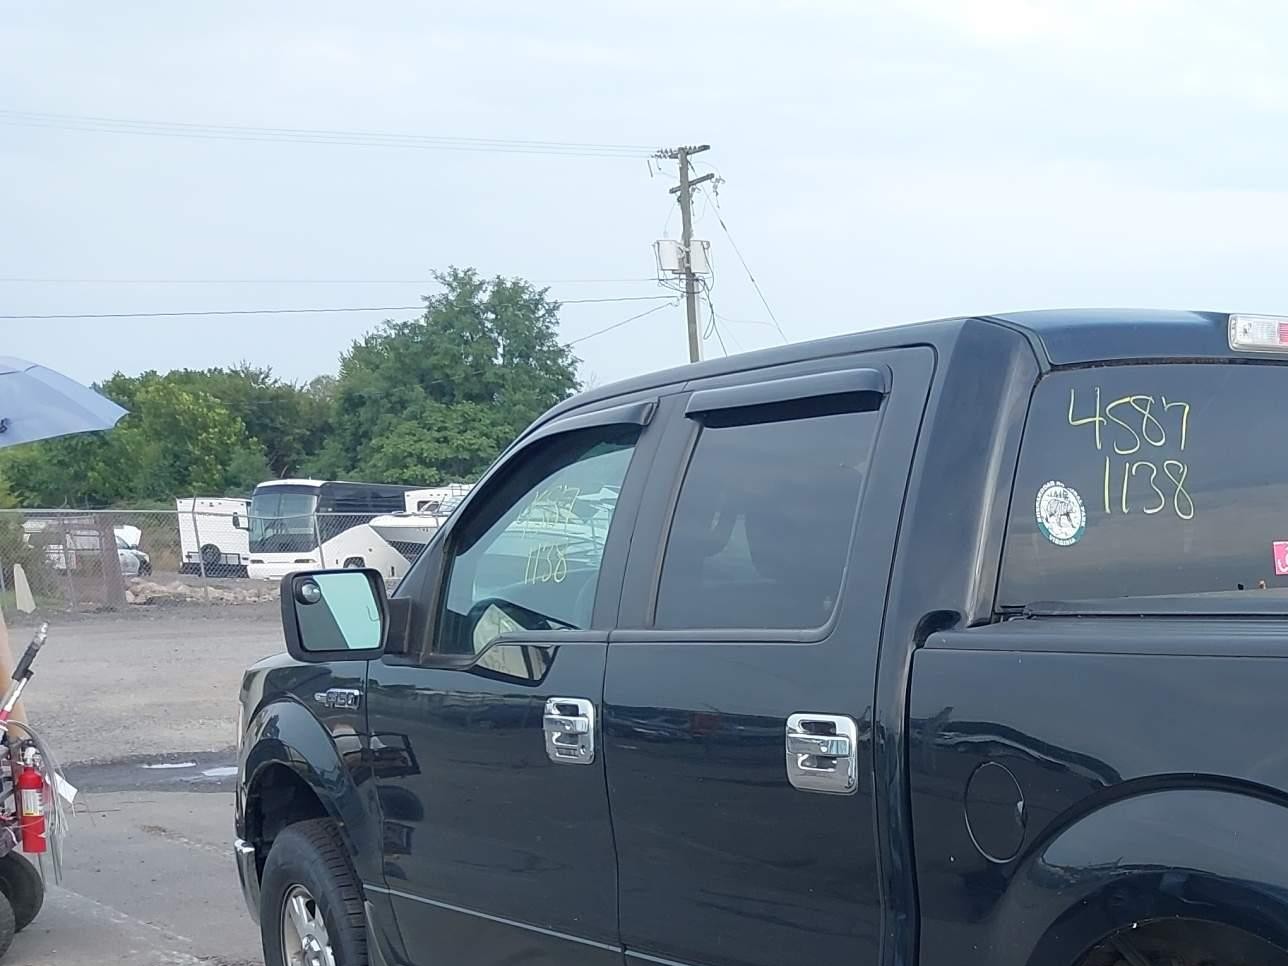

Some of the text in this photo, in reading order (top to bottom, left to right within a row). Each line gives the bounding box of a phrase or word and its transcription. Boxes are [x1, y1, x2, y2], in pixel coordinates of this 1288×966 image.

[1067, 386, 1191, 456] 4587
[1103, 455, 1195, 520] 1138
[524, 543, 568, 585] 1138
